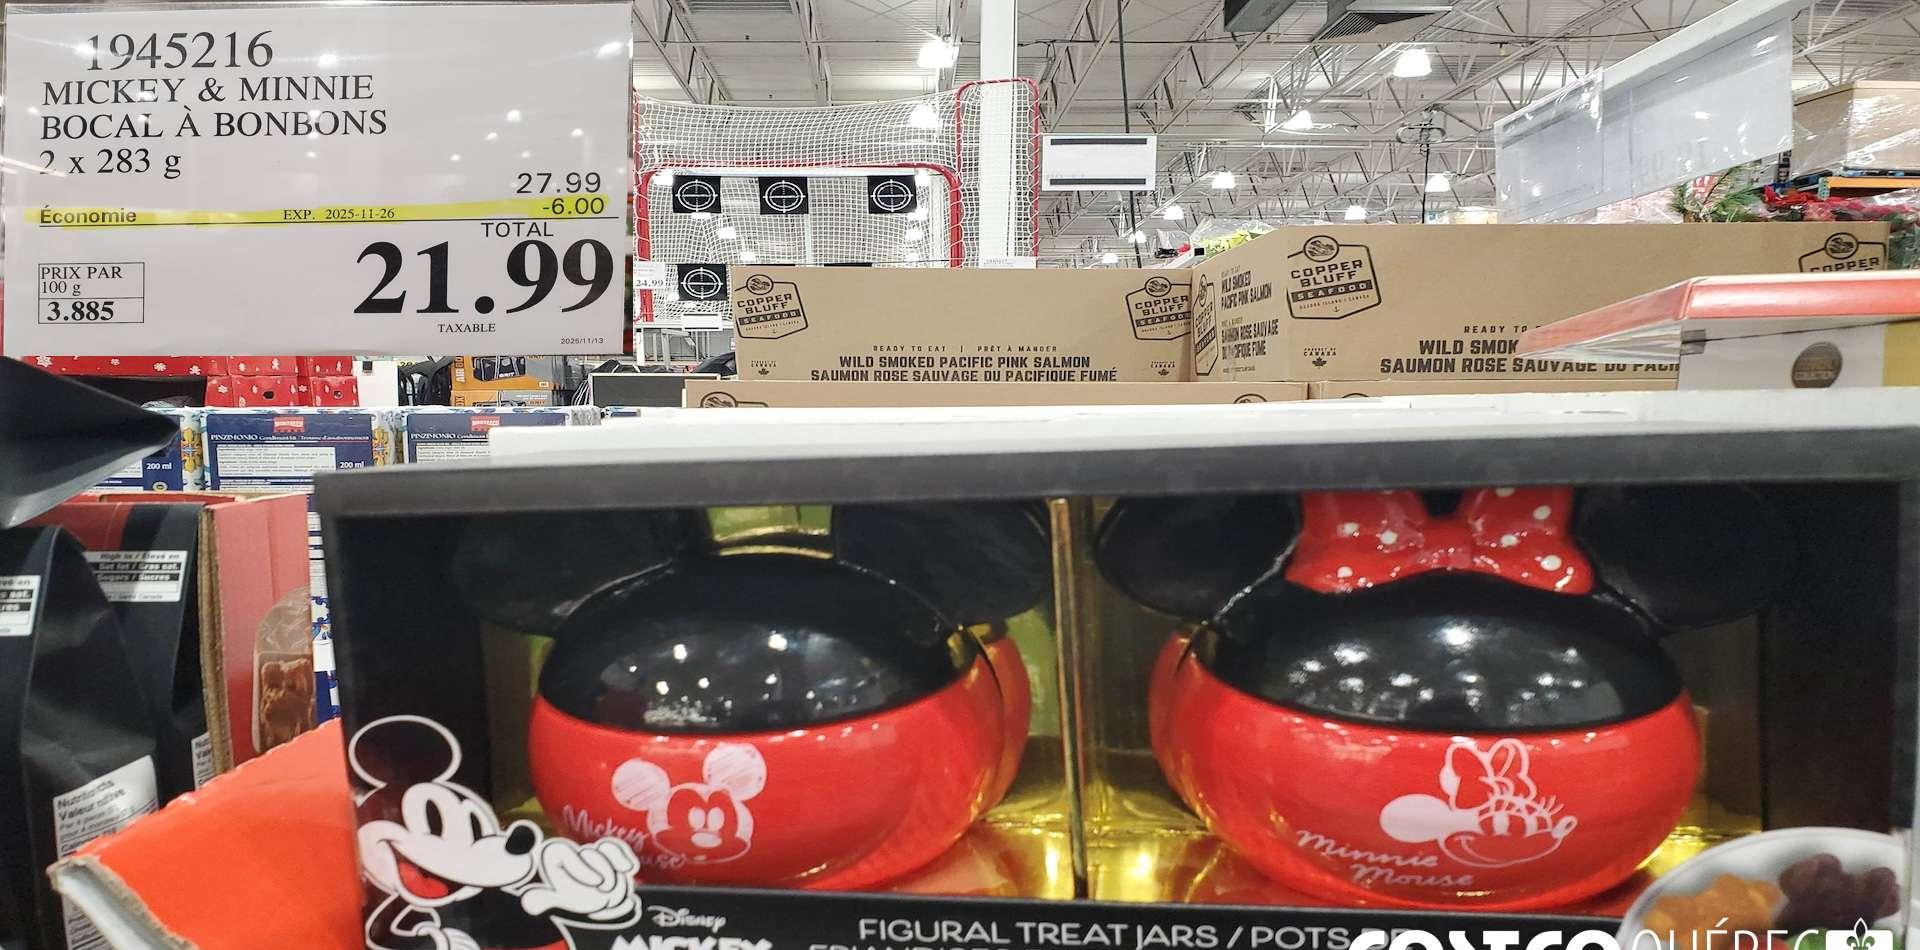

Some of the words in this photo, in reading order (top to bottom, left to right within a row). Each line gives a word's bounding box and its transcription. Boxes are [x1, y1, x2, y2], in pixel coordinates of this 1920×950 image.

[87, 30, 273, 70] 1945216
[42, 78, 185, 105] MICKEY
[198, 77, 226, 102] &
[240, 75, 374, 100] MINNIE
[40, 114, 163, 140] BOCAL
[175, 105, 201, 137] À
[213, 109, 387, 136] BONBONS
[39, 150, 56, 175] 2
[68, 156, 85, 173] x
[97, 149, 150, 173] 283
[163, 154, 181, 179] g
[516, 173, 601, 194] 27.99
[40, 205, 137, 224] Économie
[283, 209, 316, 221] EXP.
[324, 208, 395, 221] 2025-11-26
[542, 198, 605, 215] -6.00
[481, 222, 554, 237] TOTAL
[41, 267, 81, 280] PRIX
[87, 266, 123, 279] PAR
[353, 239, 614, 314] 21.99
[1291, 260, 1363, 279] COPPER
[636, 279, 664, 287] 24.99
[1300, 270, 1357, 288] BLUFF
[41, 281, 67, 294] 100
[72, 283, 81, 296] g
[1296, 283, 1368, 300] SEAFOOD
[737, 294, 793, 308] COPPER
[745, 301, 788, 315] BLUFF
[1135, 295, 1189, 310] COPPER
[46, 301, 114, 321] 3.885
[1142, 303, 1184, 316] BLUFF
[437, 323, 496, 333] TAXABLE
[1463, 325, 1506, 333] READY
[560, 337, 604, 345] 2025/11/13
[1419, 339, 1464, 355] WILD
[1470, 339, 1519, 355] SMOK
[839, 356, 874, 368] WILD
[879, 356, 935, 368] SMOKED
[939, 356, 993, 368] PACIFIC
[998, 356, 1028, 368] PINK
[1034, 356, 1090, 368] SALMON
[1380, 358, 1455, 373] SAUMON
[1462, 358, 1507, 373] ROSE
[1512, 358, 1598, 373] SAUVAGE
[811, 370, 869, 382] SAUMON
[874, 370, 909, 382] ROSE
[912, 370, 978, 382] SAUVAGE
[984, 370, 1001, 382] DU
[1005, 370, 1076, 382] PACIFIQUE
[1080, 366, 1118, 382] FUMÉ
[161, 462, 172, 470] ml
[340, 461, 353, 469] 200
[354, 460, 365, 468] ml
[1296, 829, 1439, 867] Minnie
[1351, 864, 1475, 889] Mouse
[647, 905, 728, 933] Disney
[858, 918, 1011, 943] FIGURAL
[1015, 921, 1129, 947] TREAT
[1136, 923, 1220, 950] JARS
[1226, 925, 1243, 950] /
[1250, 926, 1350, 950] POTS
